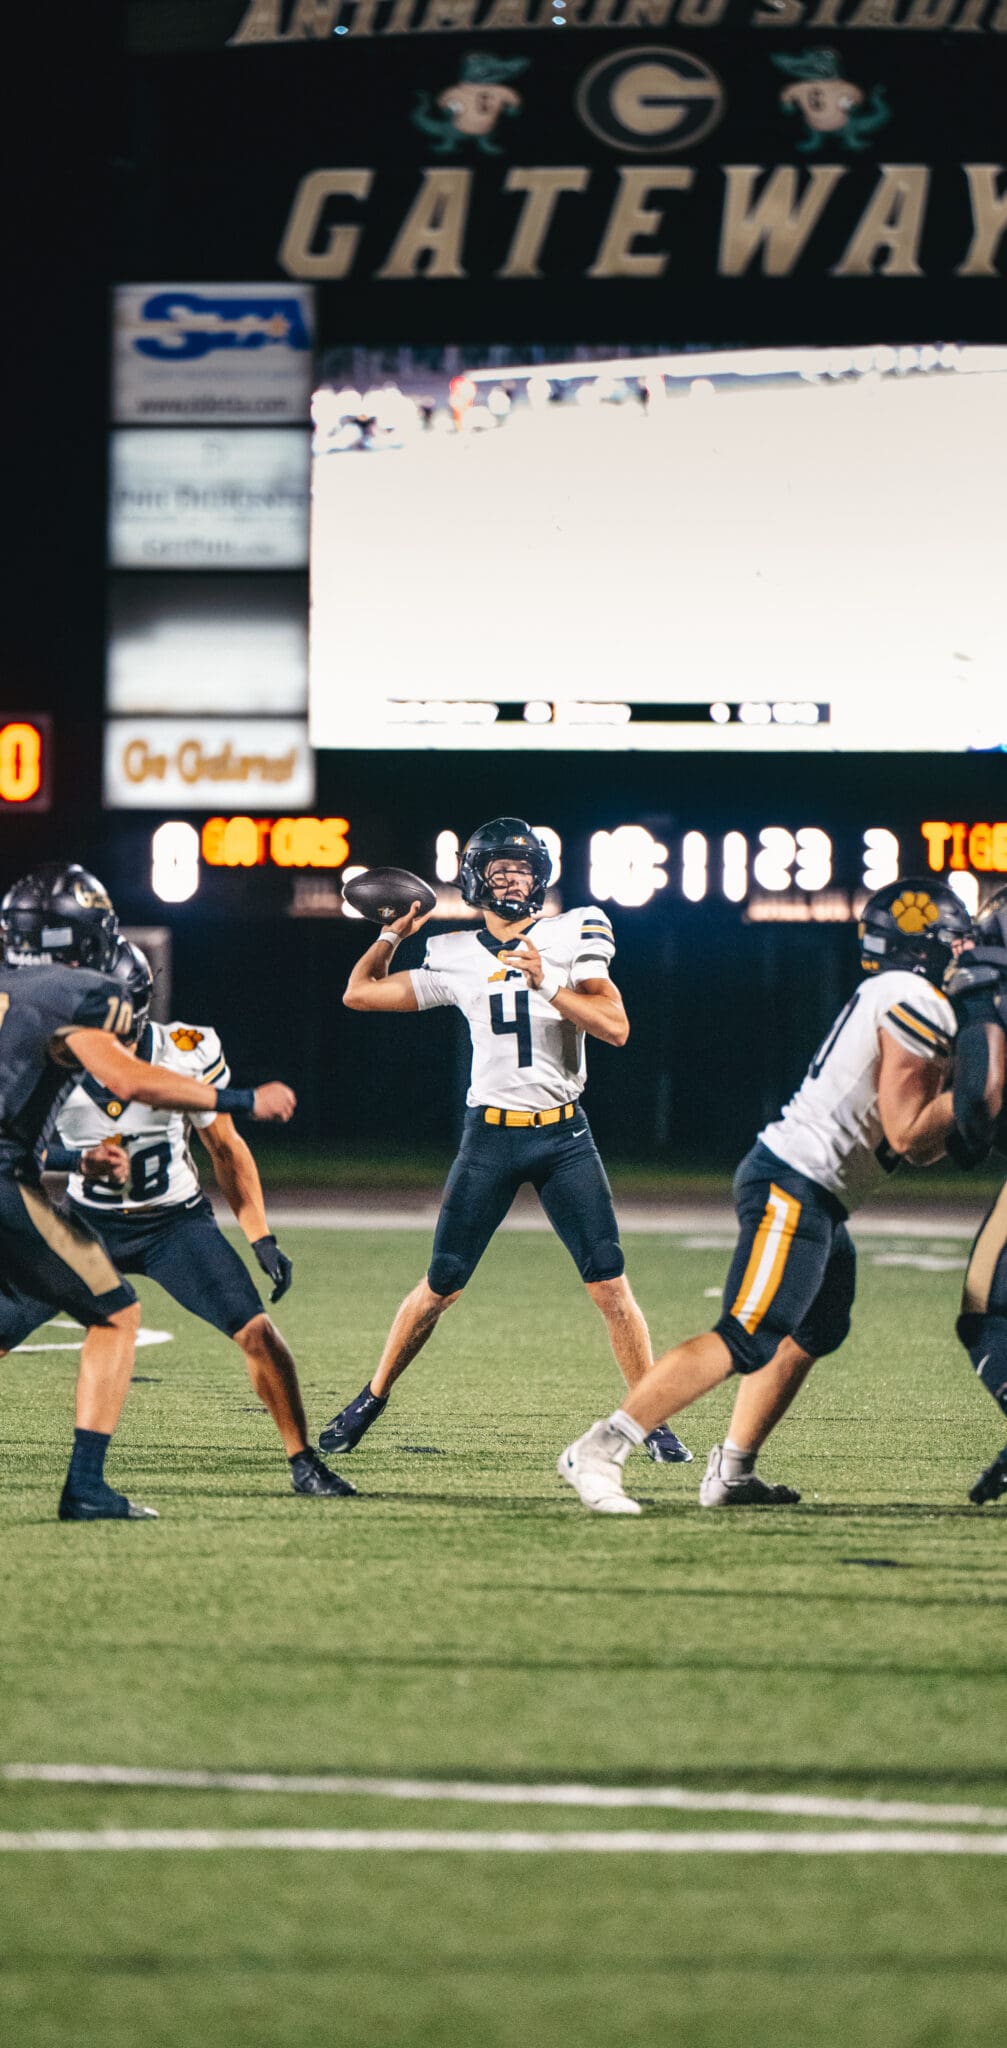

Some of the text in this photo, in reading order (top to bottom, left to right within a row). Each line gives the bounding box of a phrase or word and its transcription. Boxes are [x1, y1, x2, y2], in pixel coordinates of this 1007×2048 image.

[610, 64, 722, 134] G
[279, 167, 1007, 279] GATEWAY
[0, 721, 42, 803] 0
[755, 827, 832, 890] 23
[863, 828, 899, 890] 3
[104, 996, 133, 1034] 10
[489, 989, 533, 1068] 4
